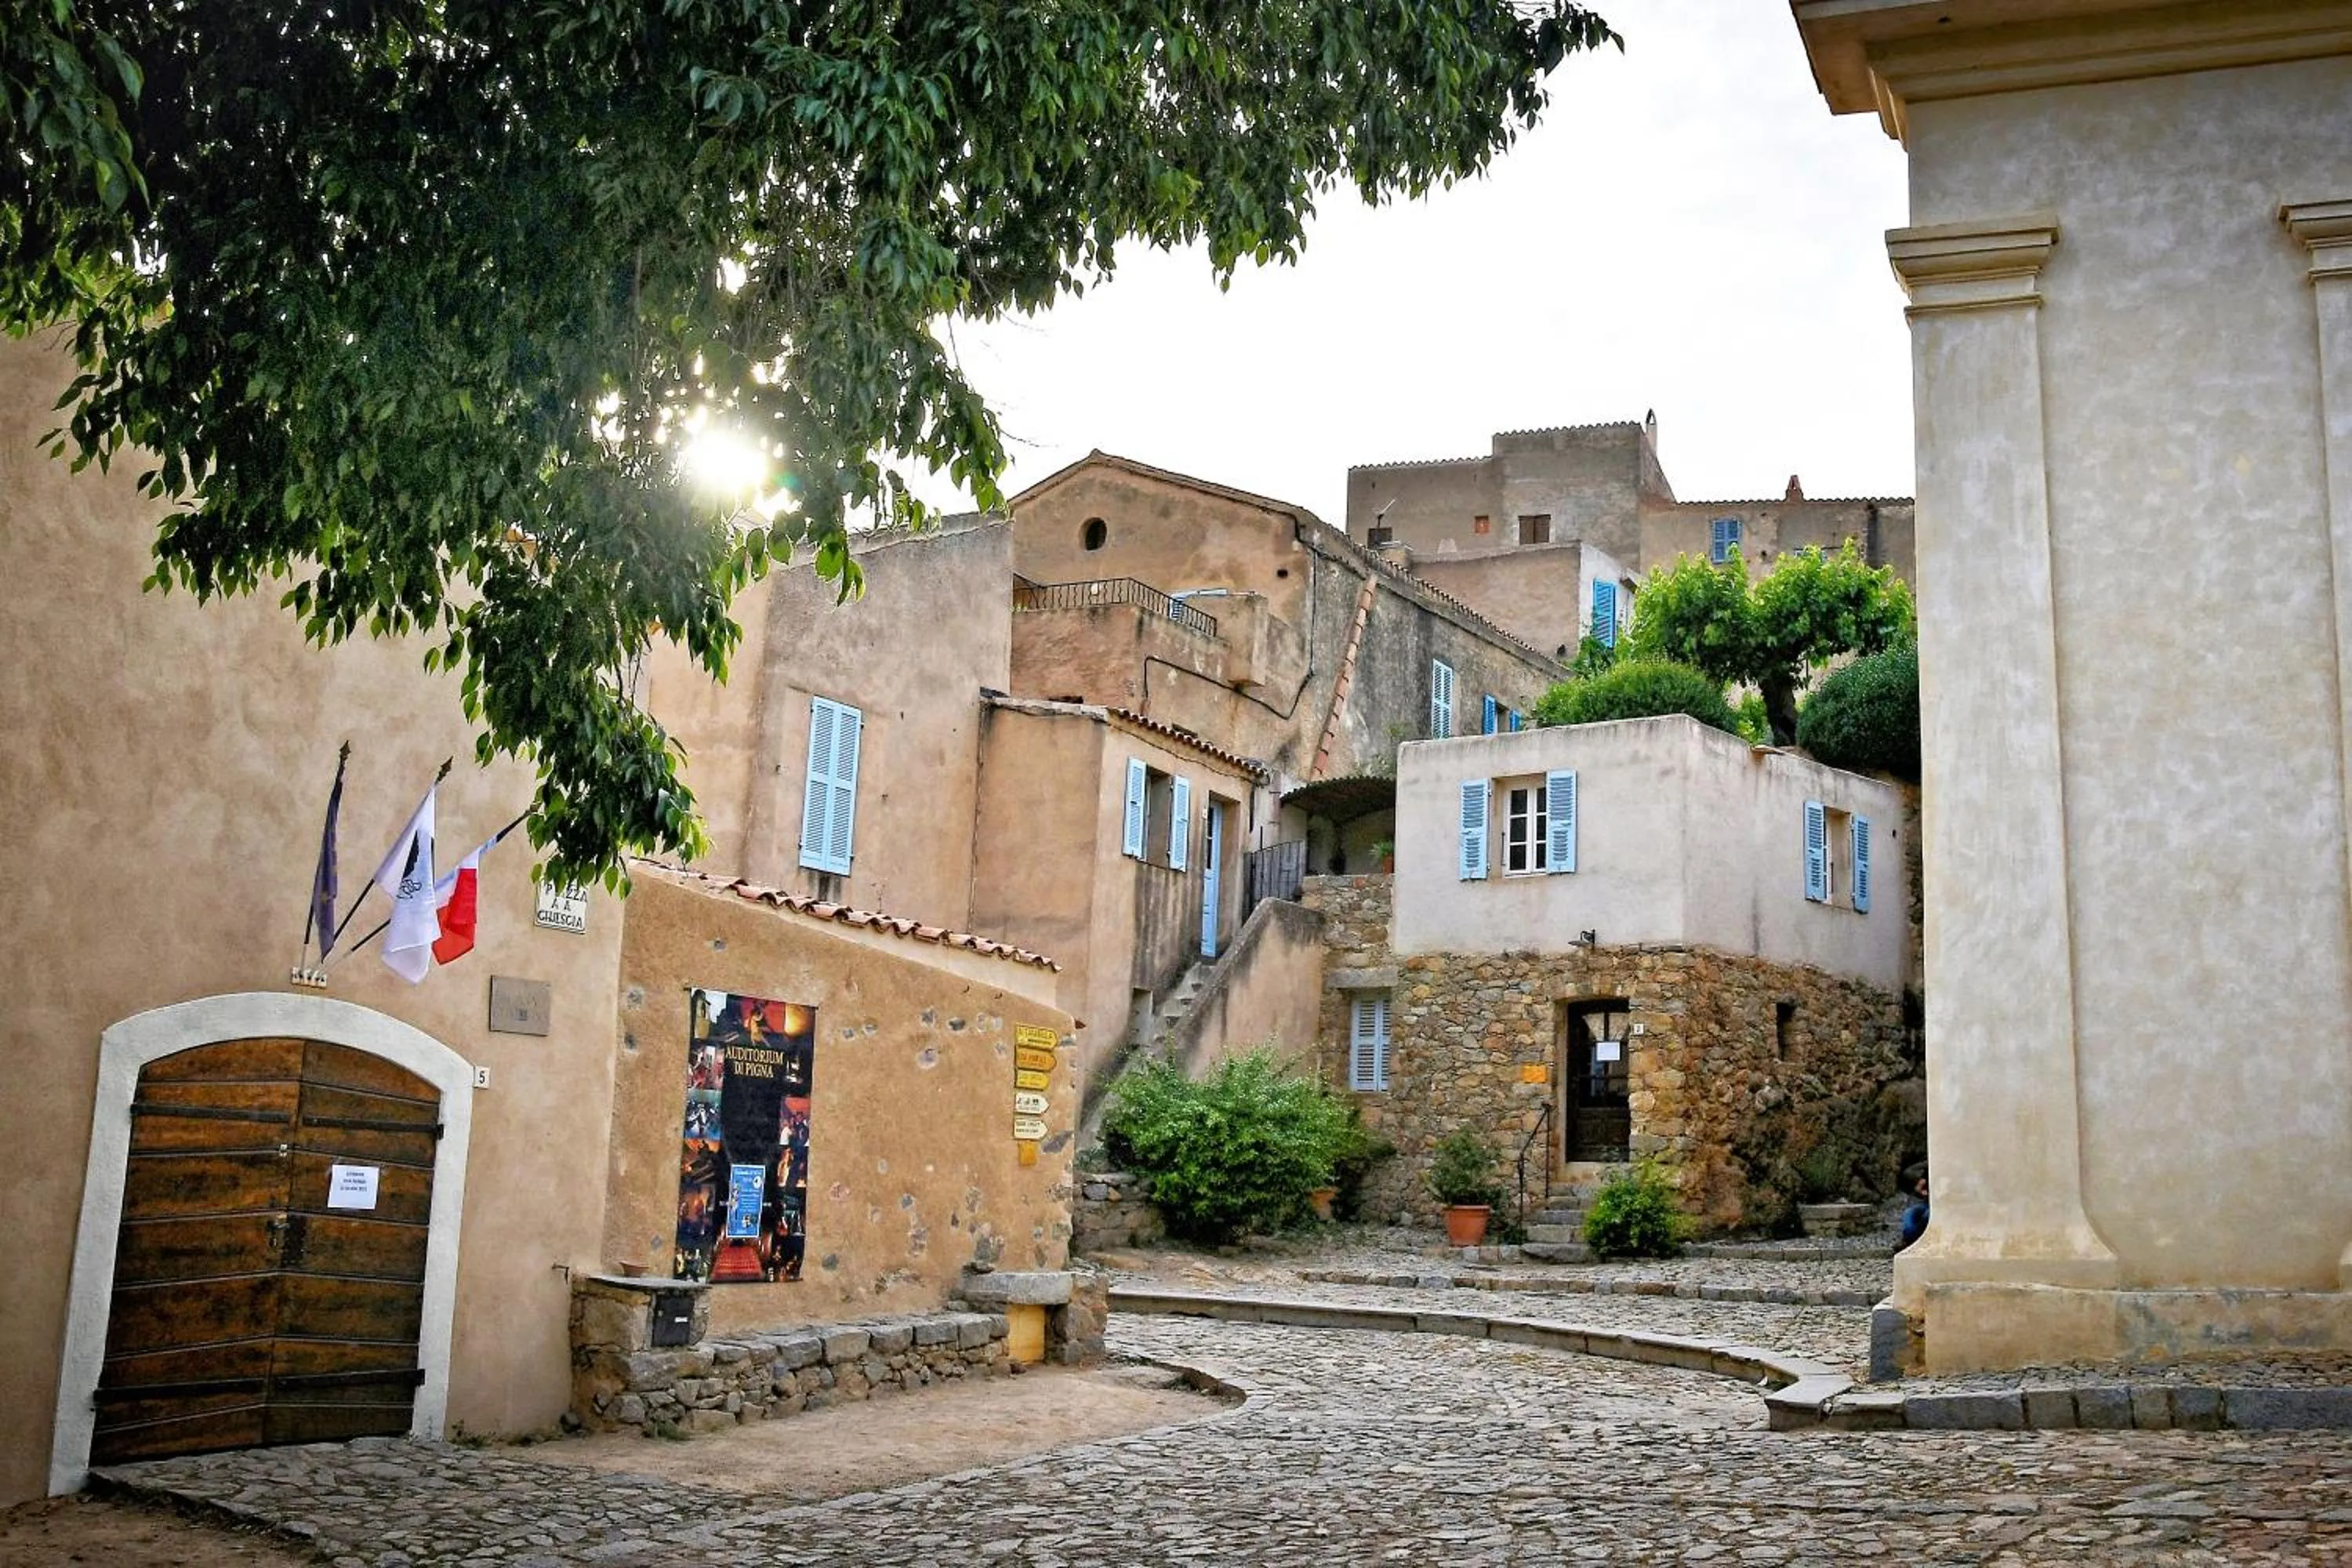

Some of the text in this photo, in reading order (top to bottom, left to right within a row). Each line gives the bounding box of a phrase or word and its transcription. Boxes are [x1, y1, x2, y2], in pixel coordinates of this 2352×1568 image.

[545, 883, 588, 903] PZZA
[726, 1045, 784, 1065] AUDITORIUM
[479, 1069, 485, 1084] 5
[734, 1061, 774, 1078] DI PIGNA
